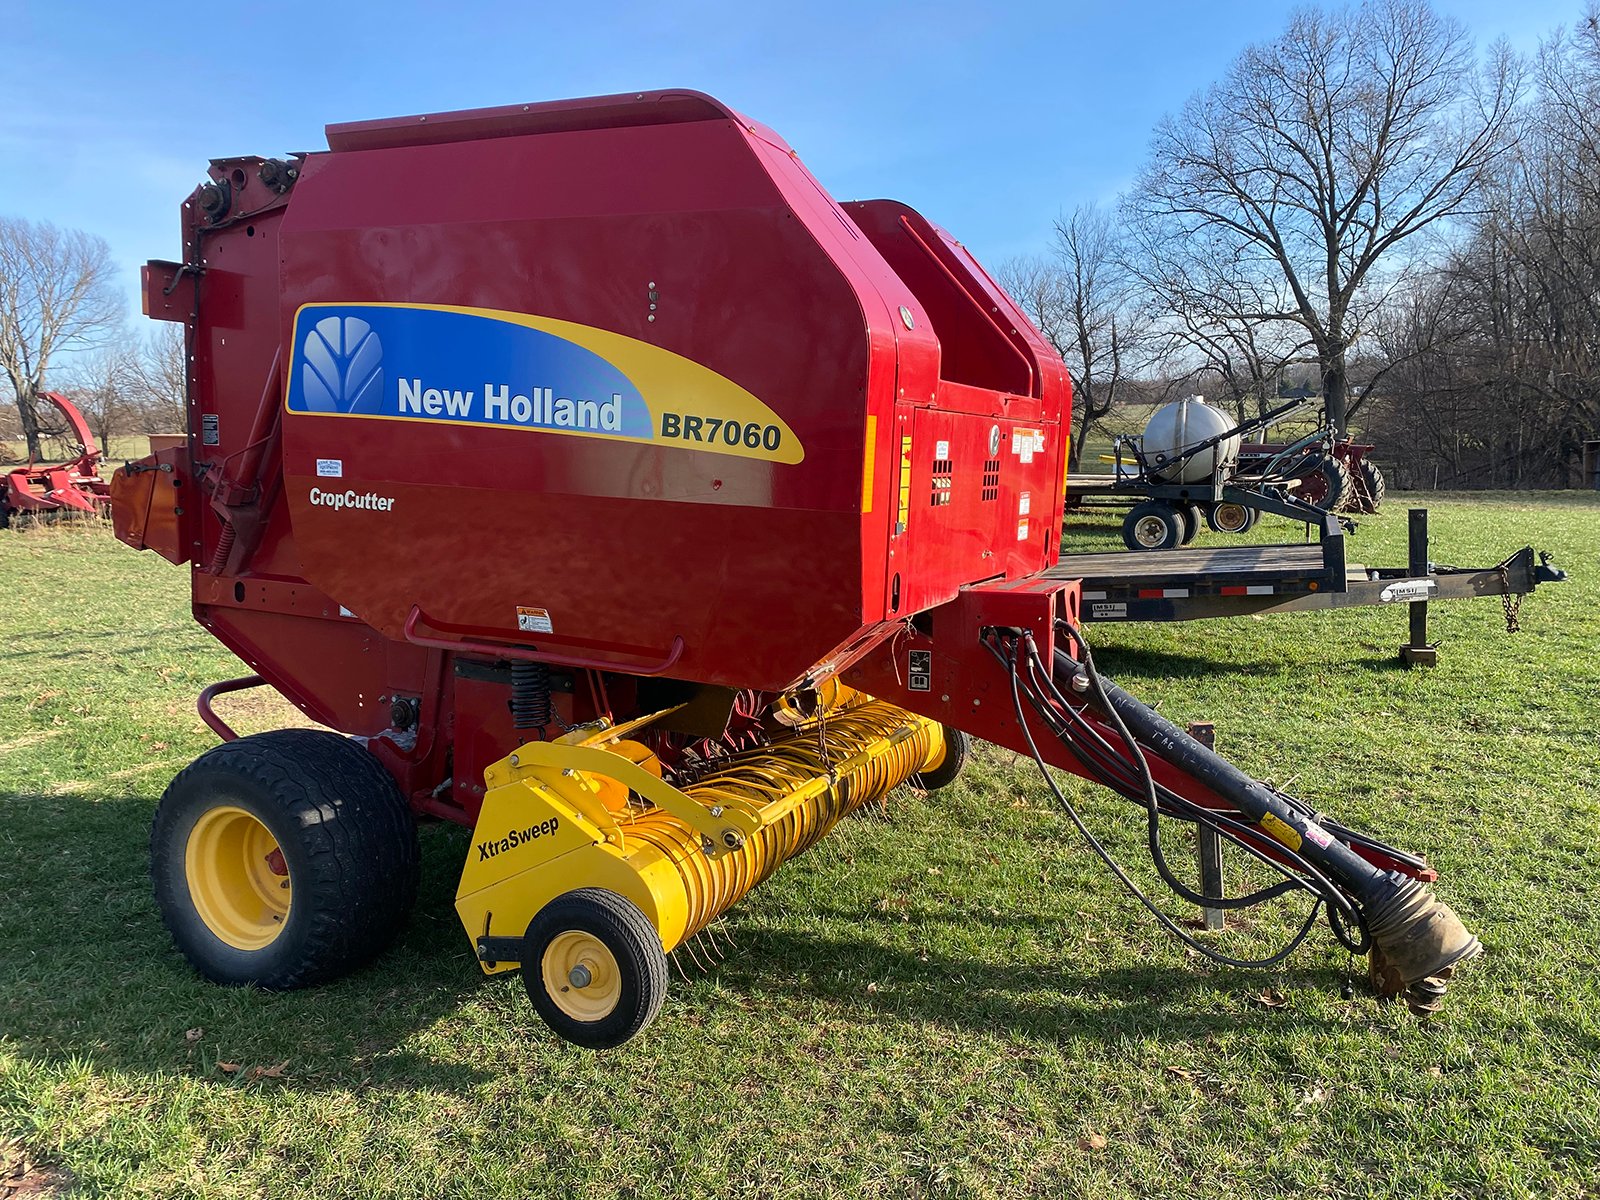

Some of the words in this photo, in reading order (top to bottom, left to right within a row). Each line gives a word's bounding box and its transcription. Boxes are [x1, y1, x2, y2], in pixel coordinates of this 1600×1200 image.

[398, 378, 474, 417] New
[484, 384, 622, 432] Holland
[661, 412, 782, 451] BR7060
[309, 487, 395, 511] CropCutter
[1151, 729, 1175, 750] TAG
[477, 816, 560, 862] XtraSweep
